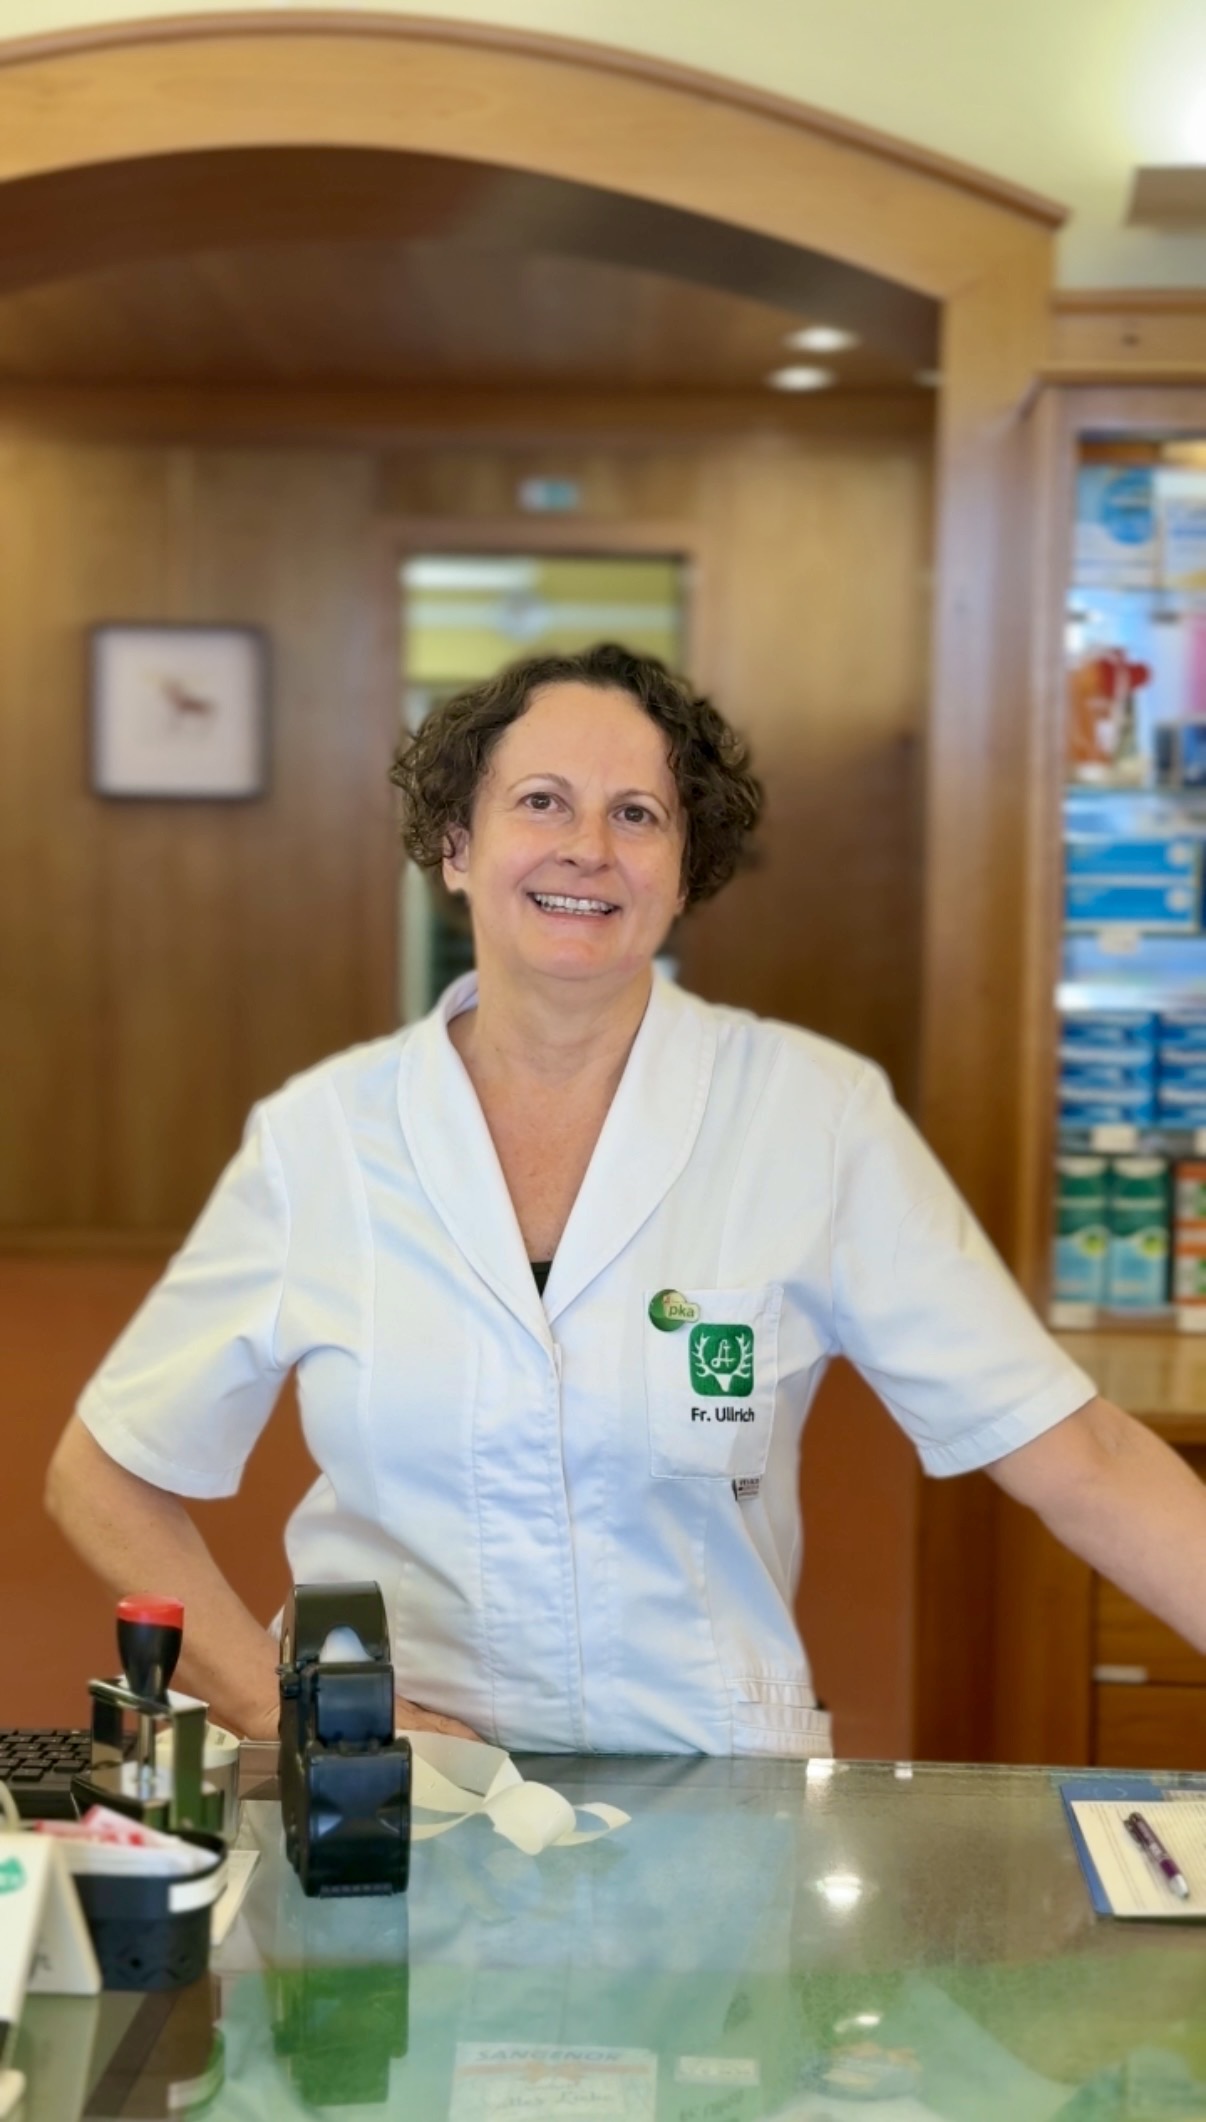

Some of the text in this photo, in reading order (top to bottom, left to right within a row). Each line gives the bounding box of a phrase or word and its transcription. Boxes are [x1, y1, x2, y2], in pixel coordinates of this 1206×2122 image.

[668, 1304, 695, 1318] pka
[691, 1406, 755, 1422] Fr. Ullrich
